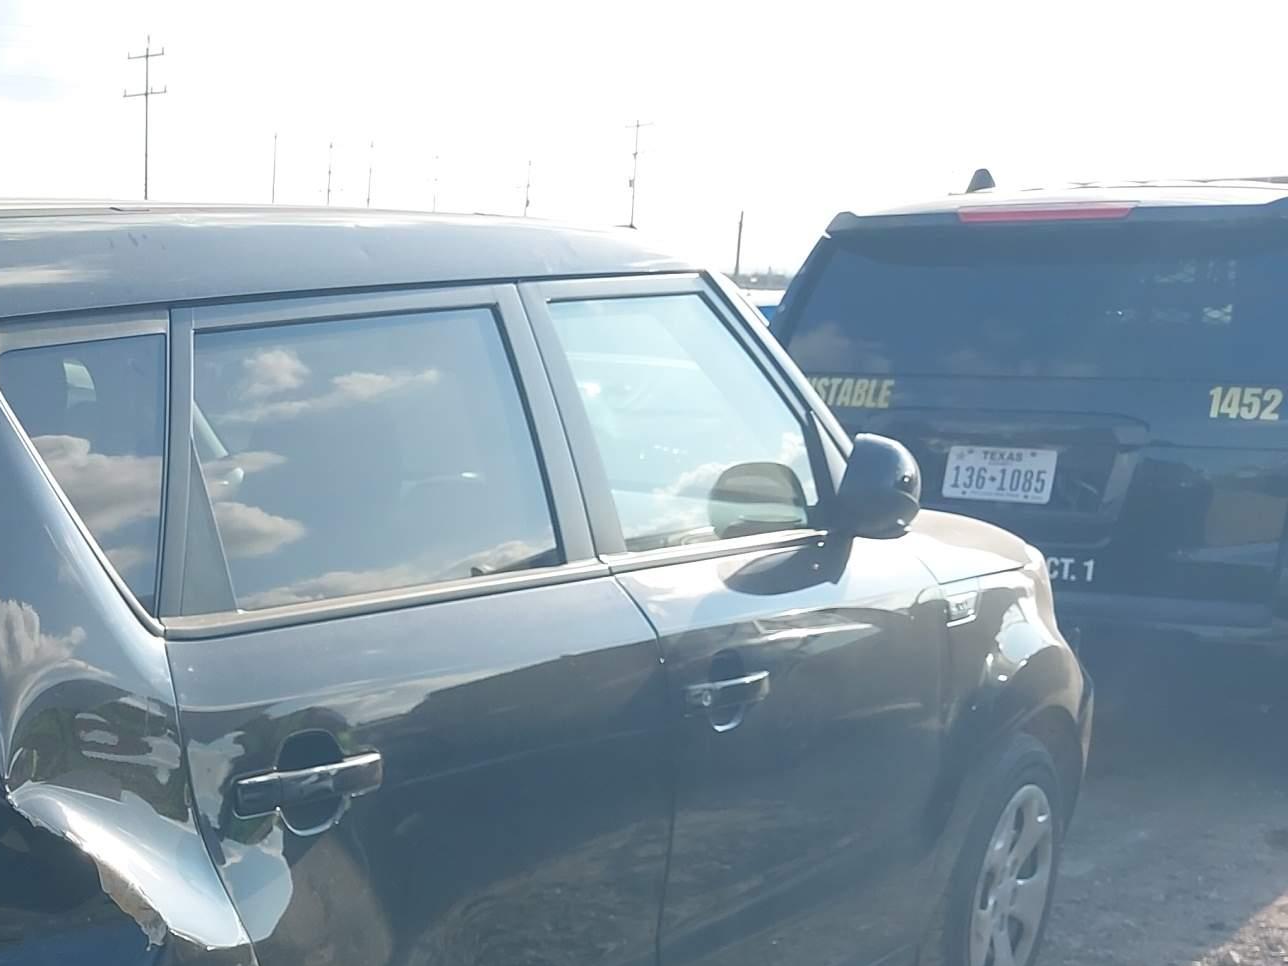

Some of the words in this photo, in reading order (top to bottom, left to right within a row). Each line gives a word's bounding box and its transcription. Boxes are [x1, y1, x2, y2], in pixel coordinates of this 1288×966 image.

[808, 377, 895, 408] STABLE
[1209, 386, 1284, 420] 1452
[982, 451, 1024, 462] TEXAS
[1047, 556, 1076, 581] CT.
[1083, 559, 1095, 581] 1
